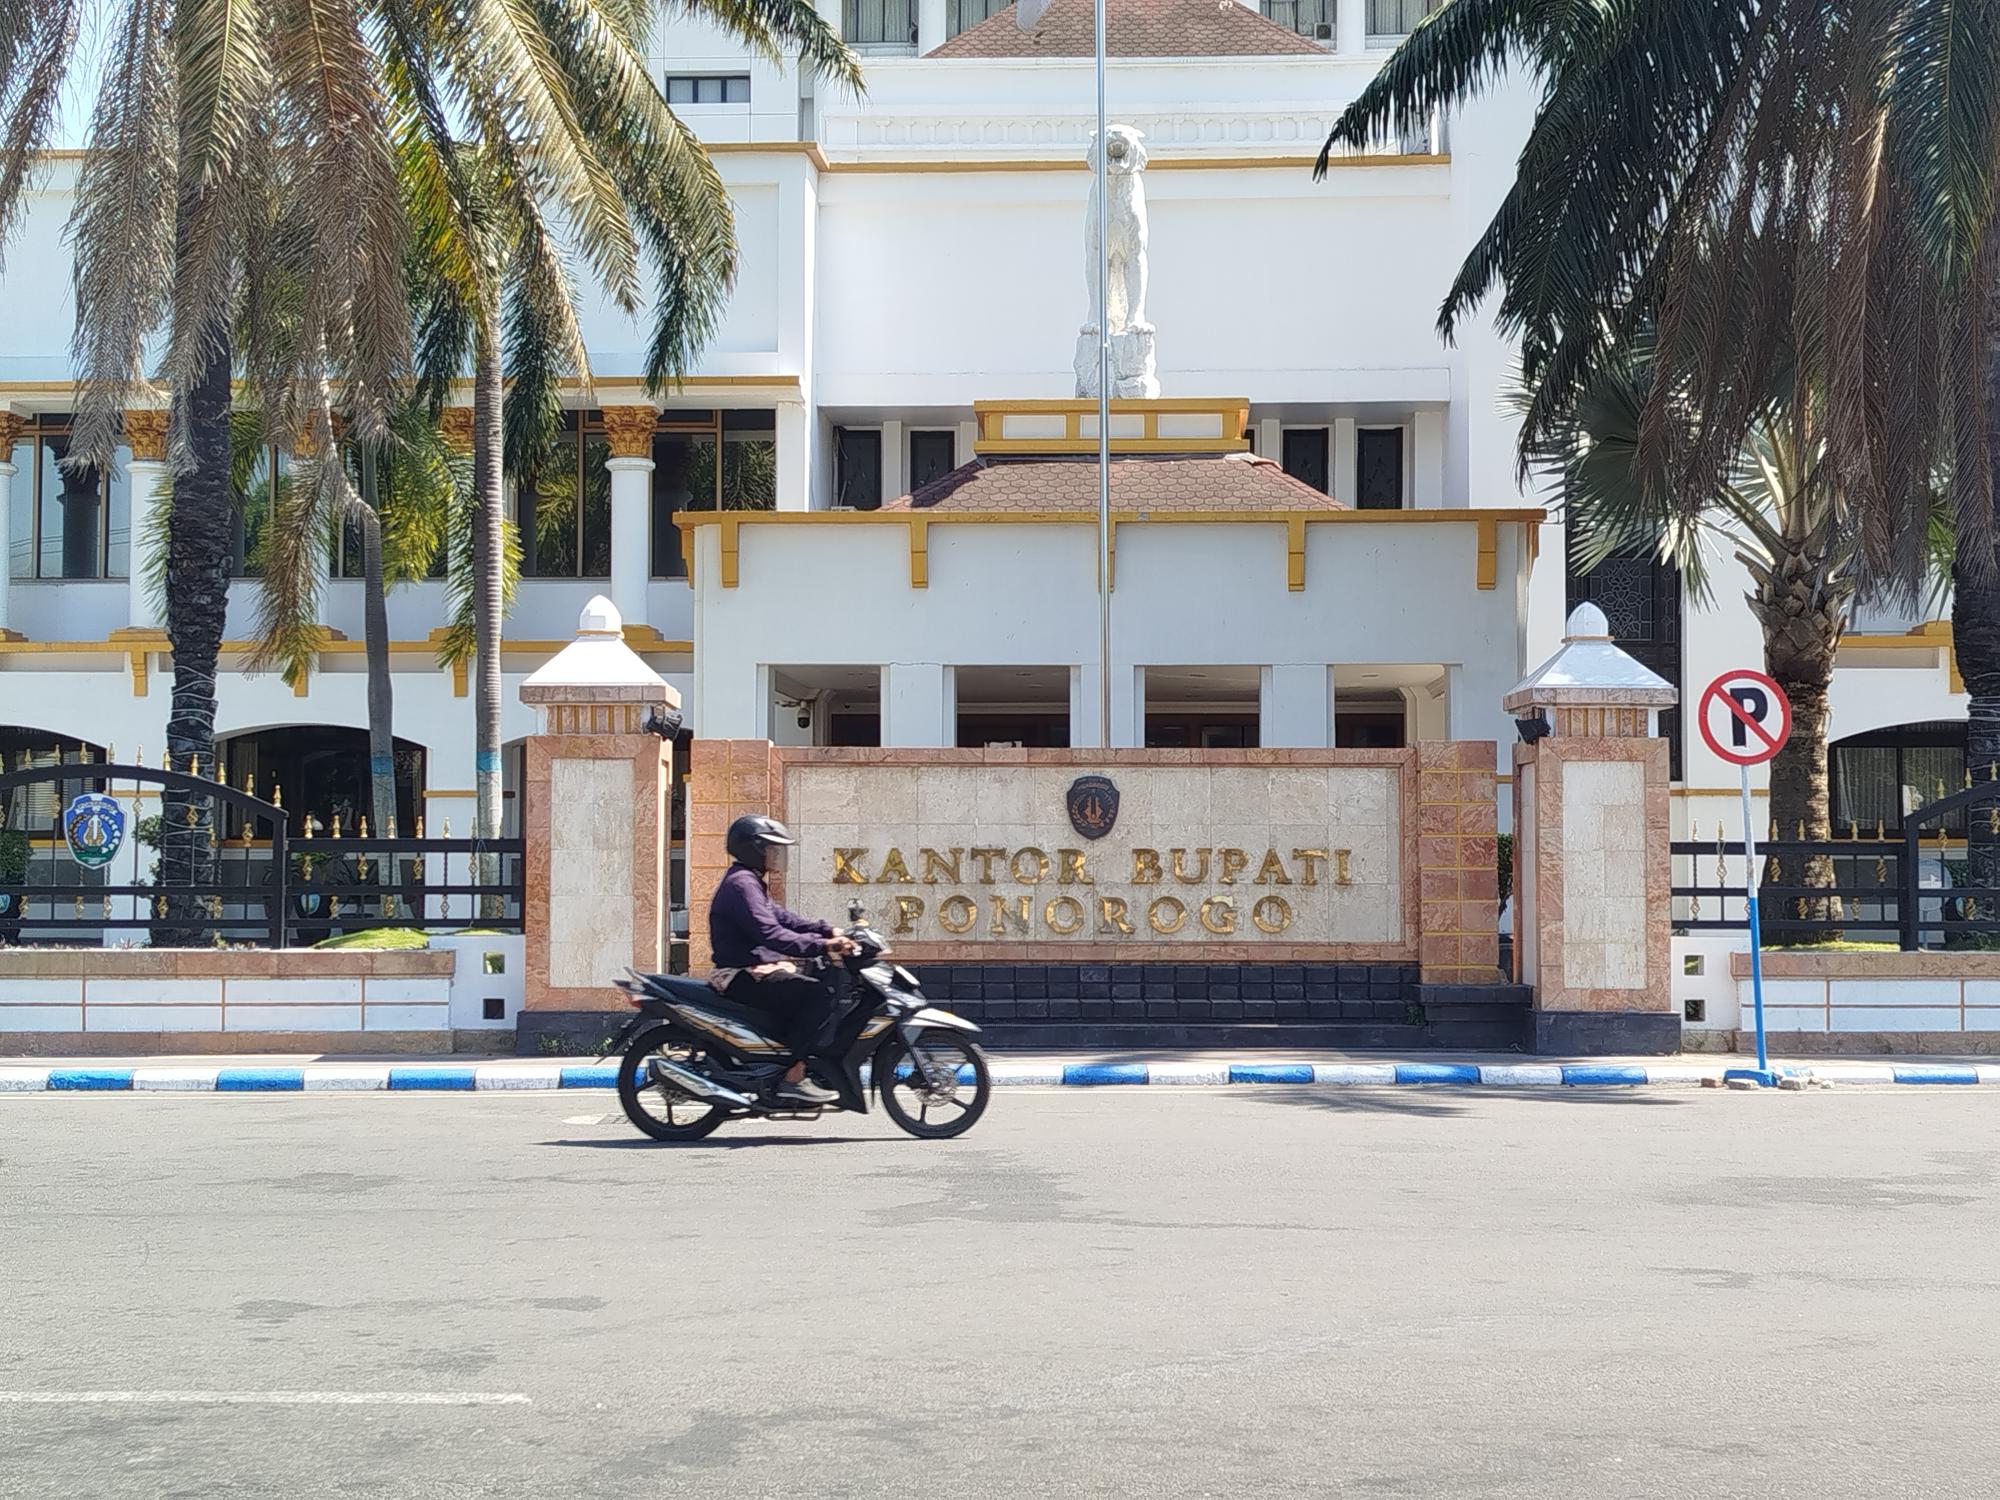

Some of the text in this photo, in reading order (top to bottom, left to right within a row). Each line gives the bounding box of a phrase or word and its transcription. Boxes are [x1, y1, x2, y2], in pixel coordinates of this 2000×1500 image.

[1729, 687, 1768, 747] P
[833, 846, 1352, 885] KANTOR BUPATI
[893, 895, 1292, 934] PONOROGO
